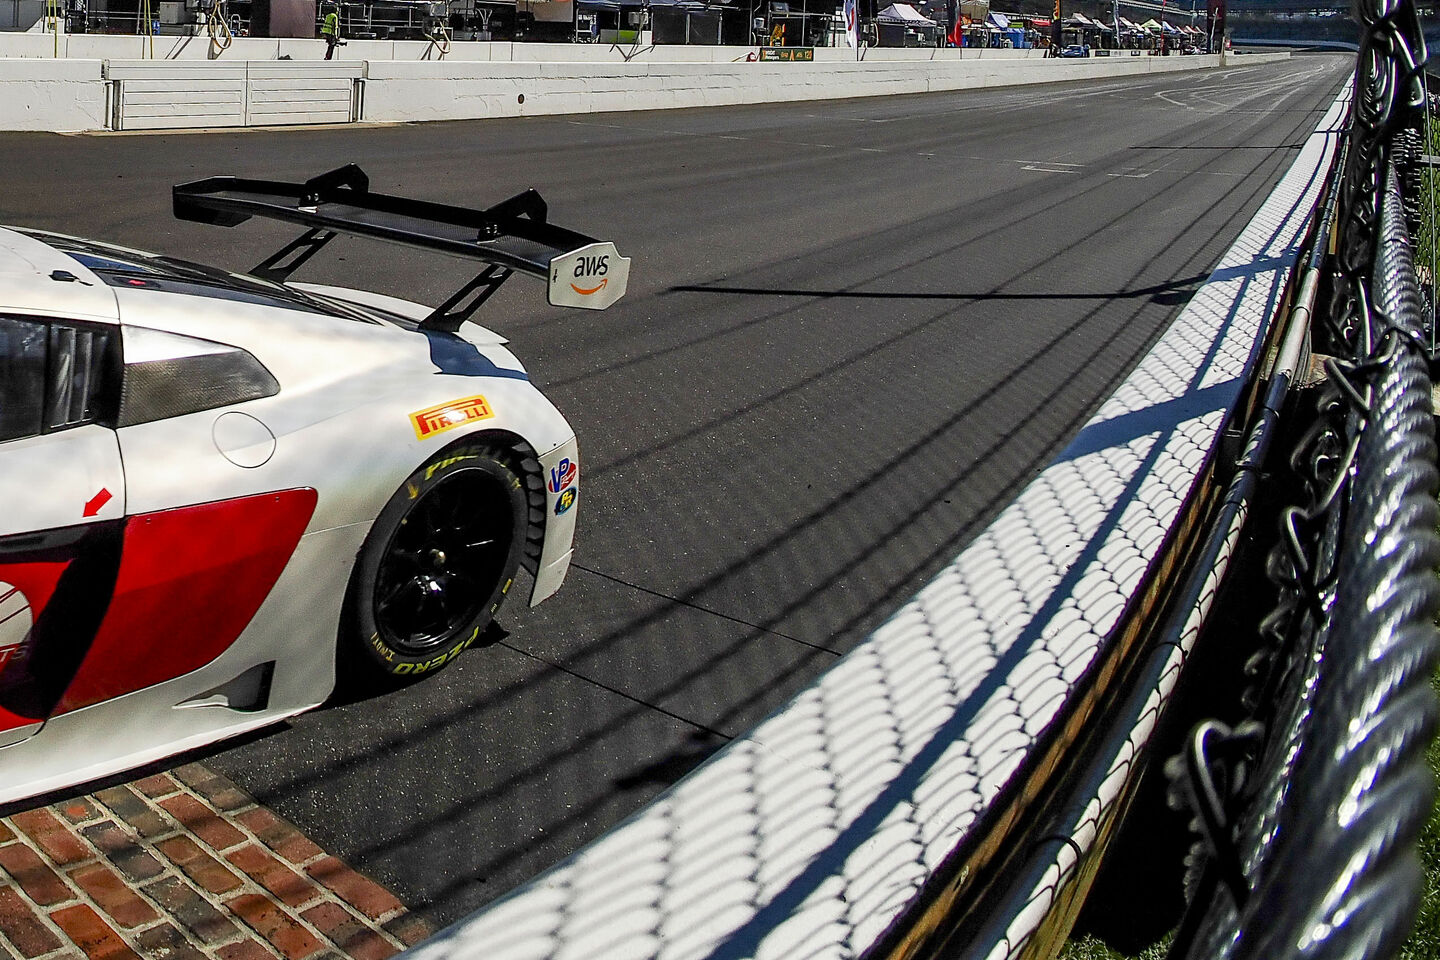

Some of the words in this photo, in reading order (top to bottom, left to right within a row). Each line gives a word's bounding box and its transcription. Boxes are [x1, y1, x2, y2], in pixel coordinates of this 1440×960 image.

[574, 255, 609, 278] aws
[415, 398, 489, 435] PIRLLI
[551, 457, 570, 493] VP
[392, 641, 465, 675] ZERO
